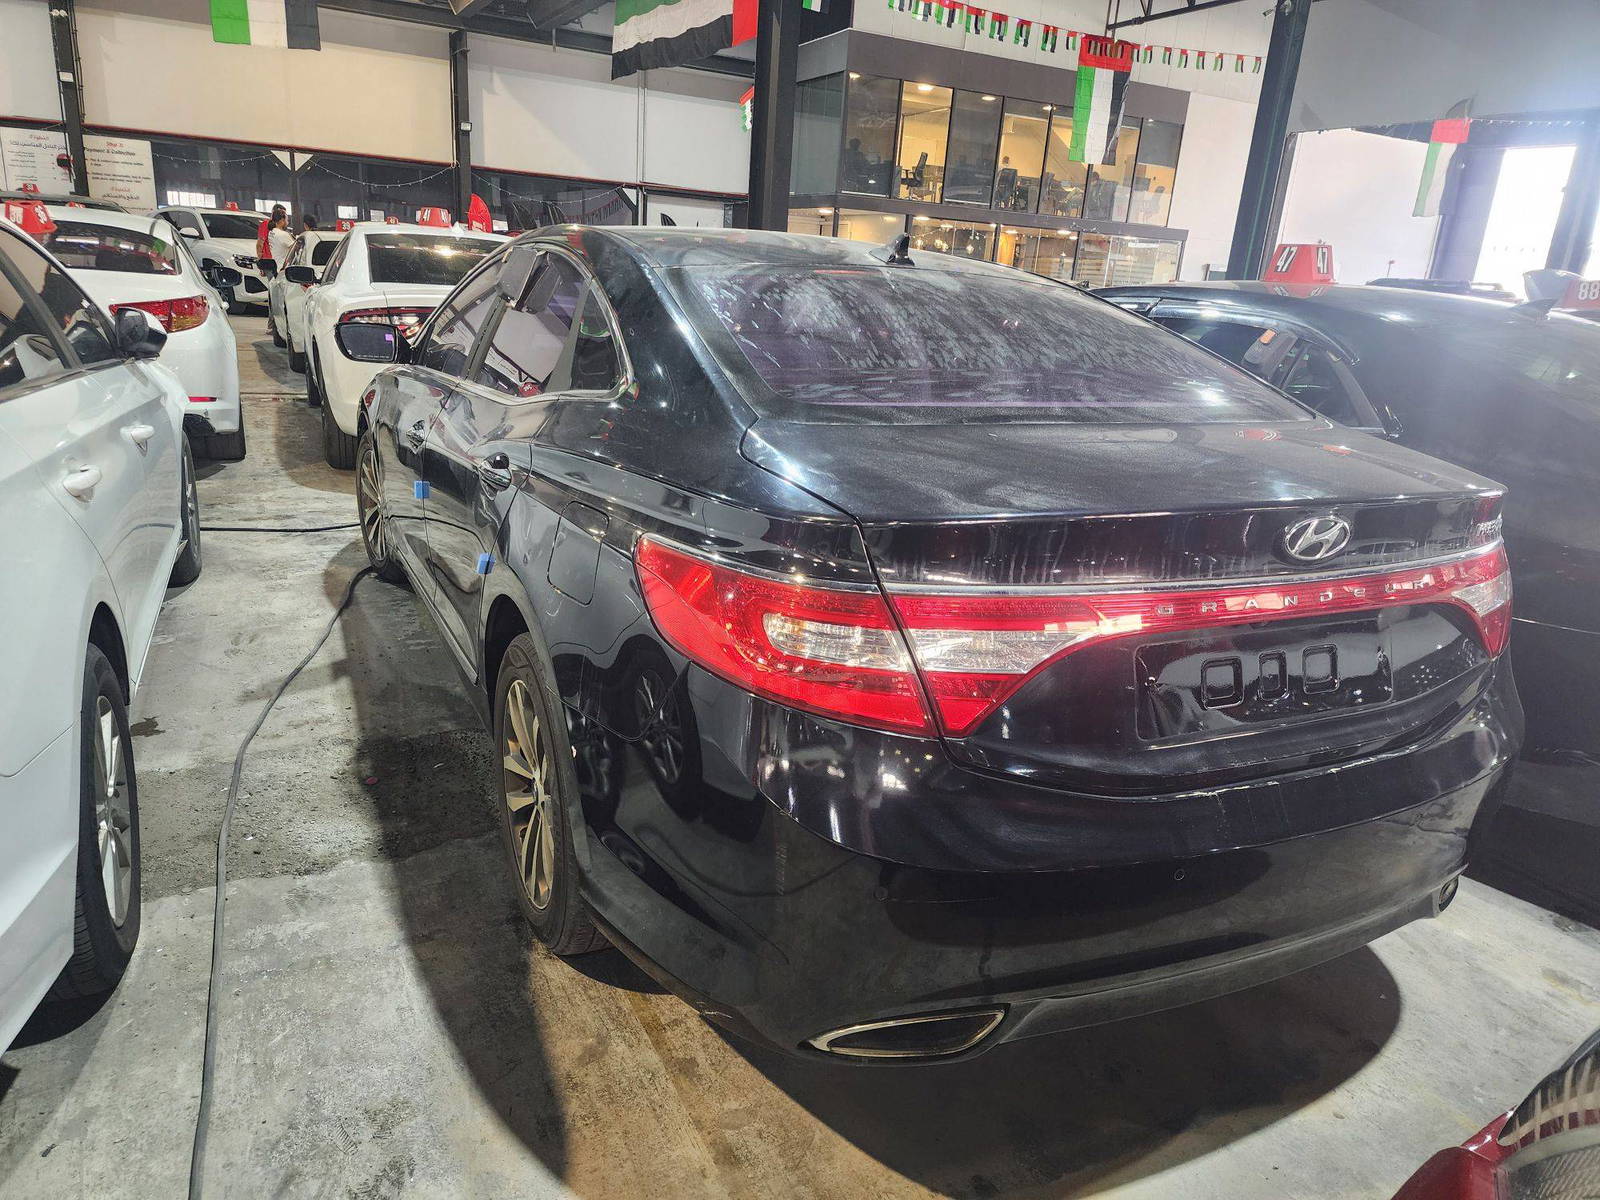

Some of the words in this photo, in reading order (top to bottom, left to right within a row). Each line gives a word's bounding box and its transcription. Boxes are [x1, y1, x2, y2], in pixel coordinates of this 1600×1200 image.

[1275, 246, 1298, 272] 47
[1317, 247, 1328, 274] 47
[1578, 280, 1600, 300] 88
[1157, 576, 1425, 615] GRANDEUR
